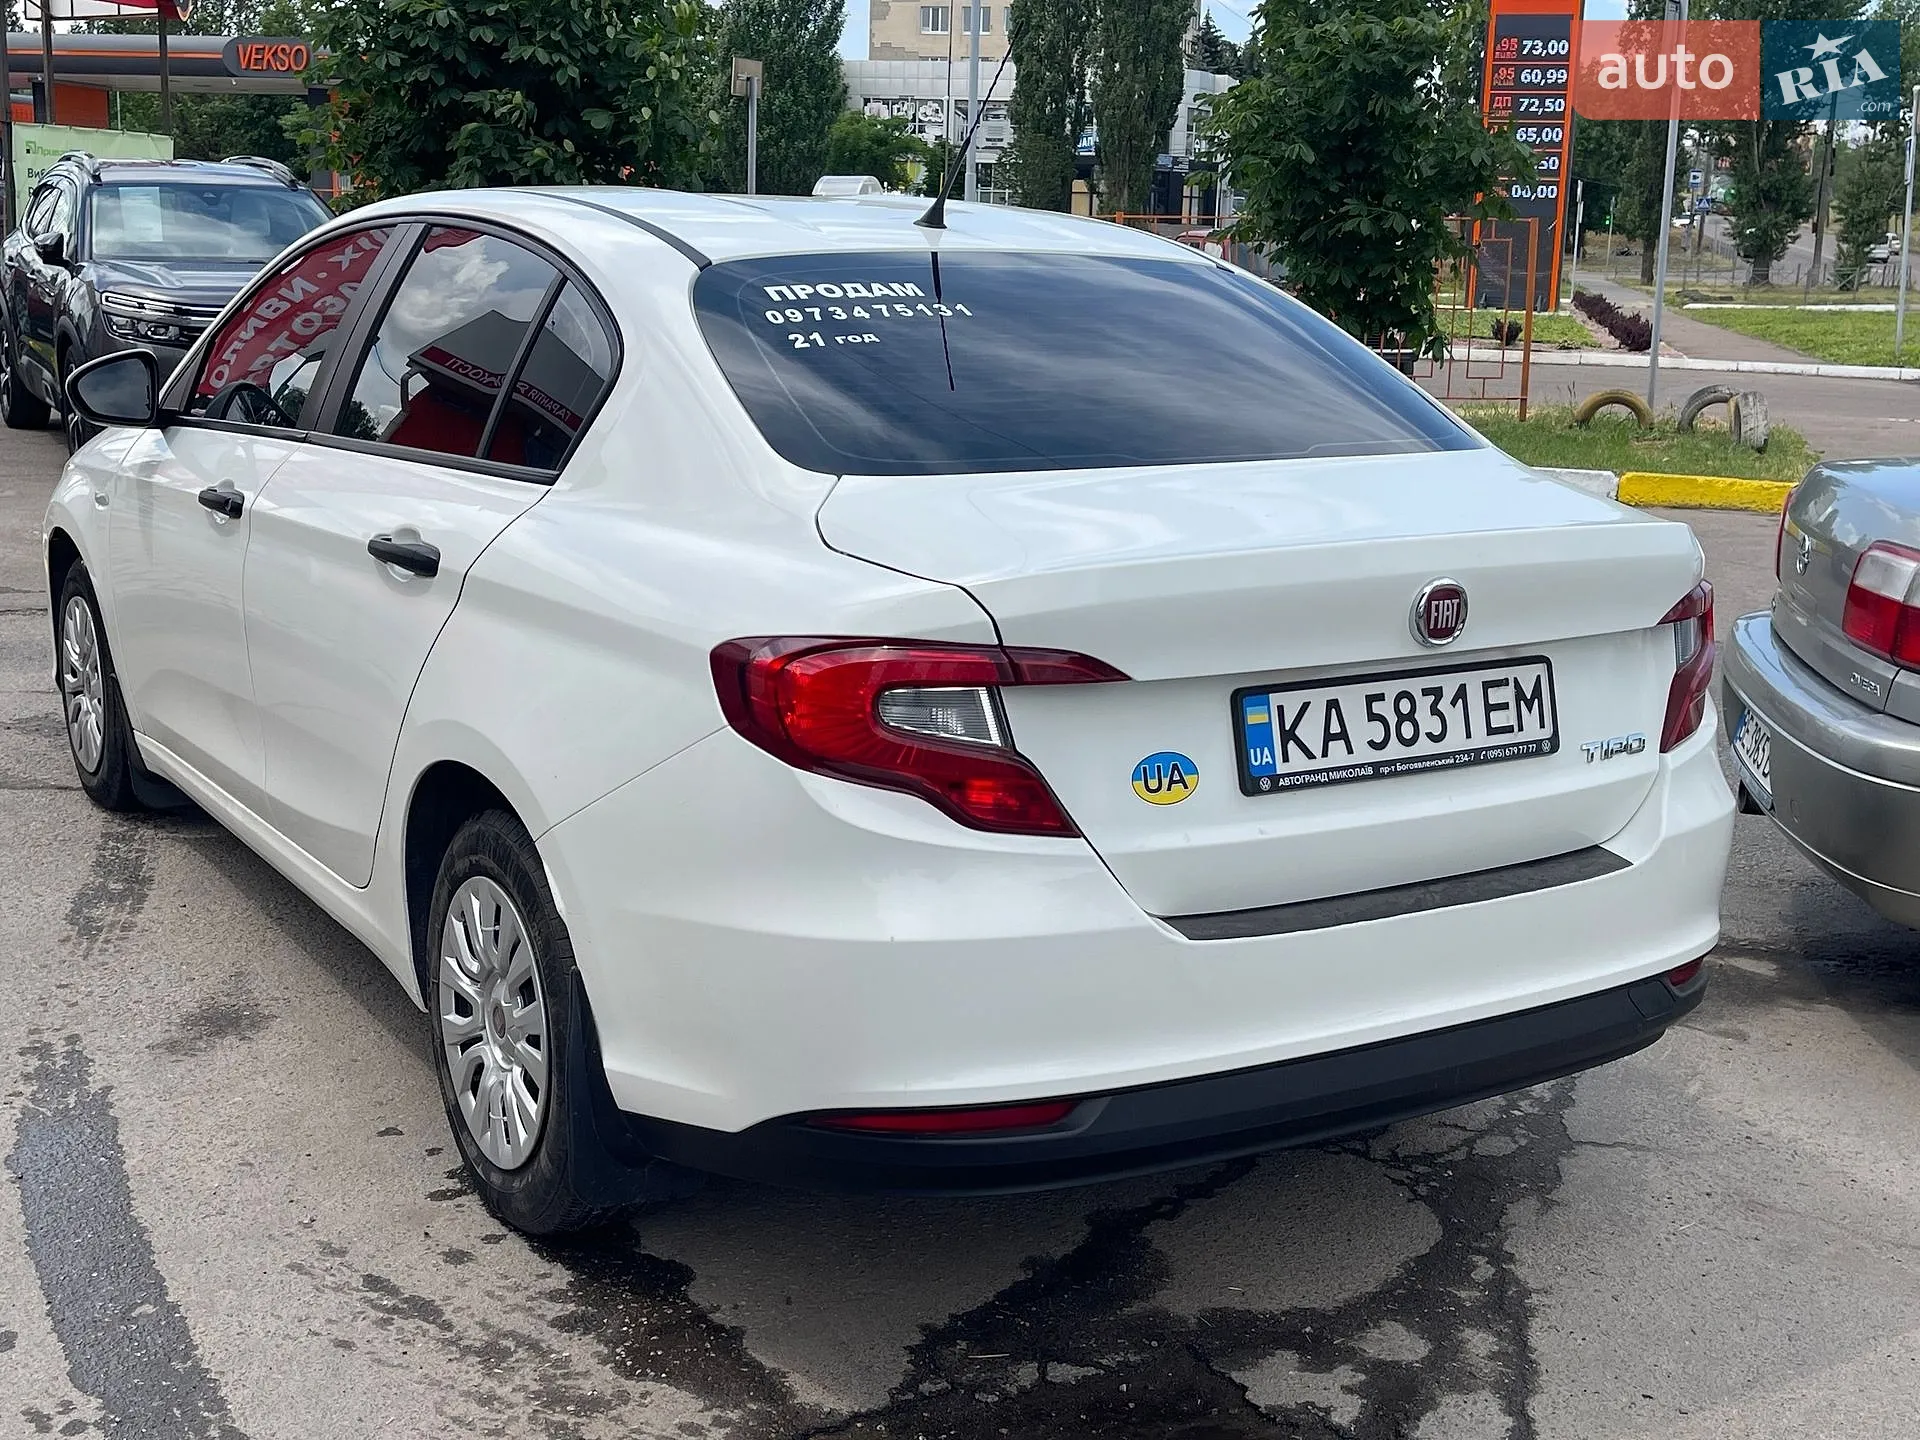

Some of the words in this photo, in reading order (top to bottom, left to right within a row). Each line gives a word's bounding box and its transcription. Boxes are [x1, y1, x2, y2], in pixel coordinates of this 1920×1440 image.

[237, 43, 308, 71] VEKSO
[1522, 39, 1569, 57] 73,00
[1520, 68, 1568, 86] 60,99
[1519, 98, 1566, 115] 72,50
[1516, 127, 1563, 144] 65,00
[763, 282, 925, 302] ПРОДАМ
[764, 302, 973, 325] 0973475131
[787, 331, 826, 349] 21
[834, 333, 880, 345] год
[1429, 598, 1460, 630] FIAT
[1275, 698, 1355, 764] KA
[1363, 682, 1473, 751] 5831
[1481, 673, 1547, 737] EM
[1250, 746, 1274, 766] UA
[1580, 732, 1646, 763] TIPO
[1278, 772, 1329, 787] АВТОГРАНД
[1329, 765, 1374, 780] МИКОЛАЇВ
[1396, 755, 1455, 772] Богоявленський
[1455, 752, 1475, 764] 234-7
[1486, 748, 1505, 760] (095)
[1505, 745, 1518, 757] 679
[1518, 744, 1528, 755] 77
[1528, 743, 1537, 753] 77
[1141, 762, 1189, 794] UA
